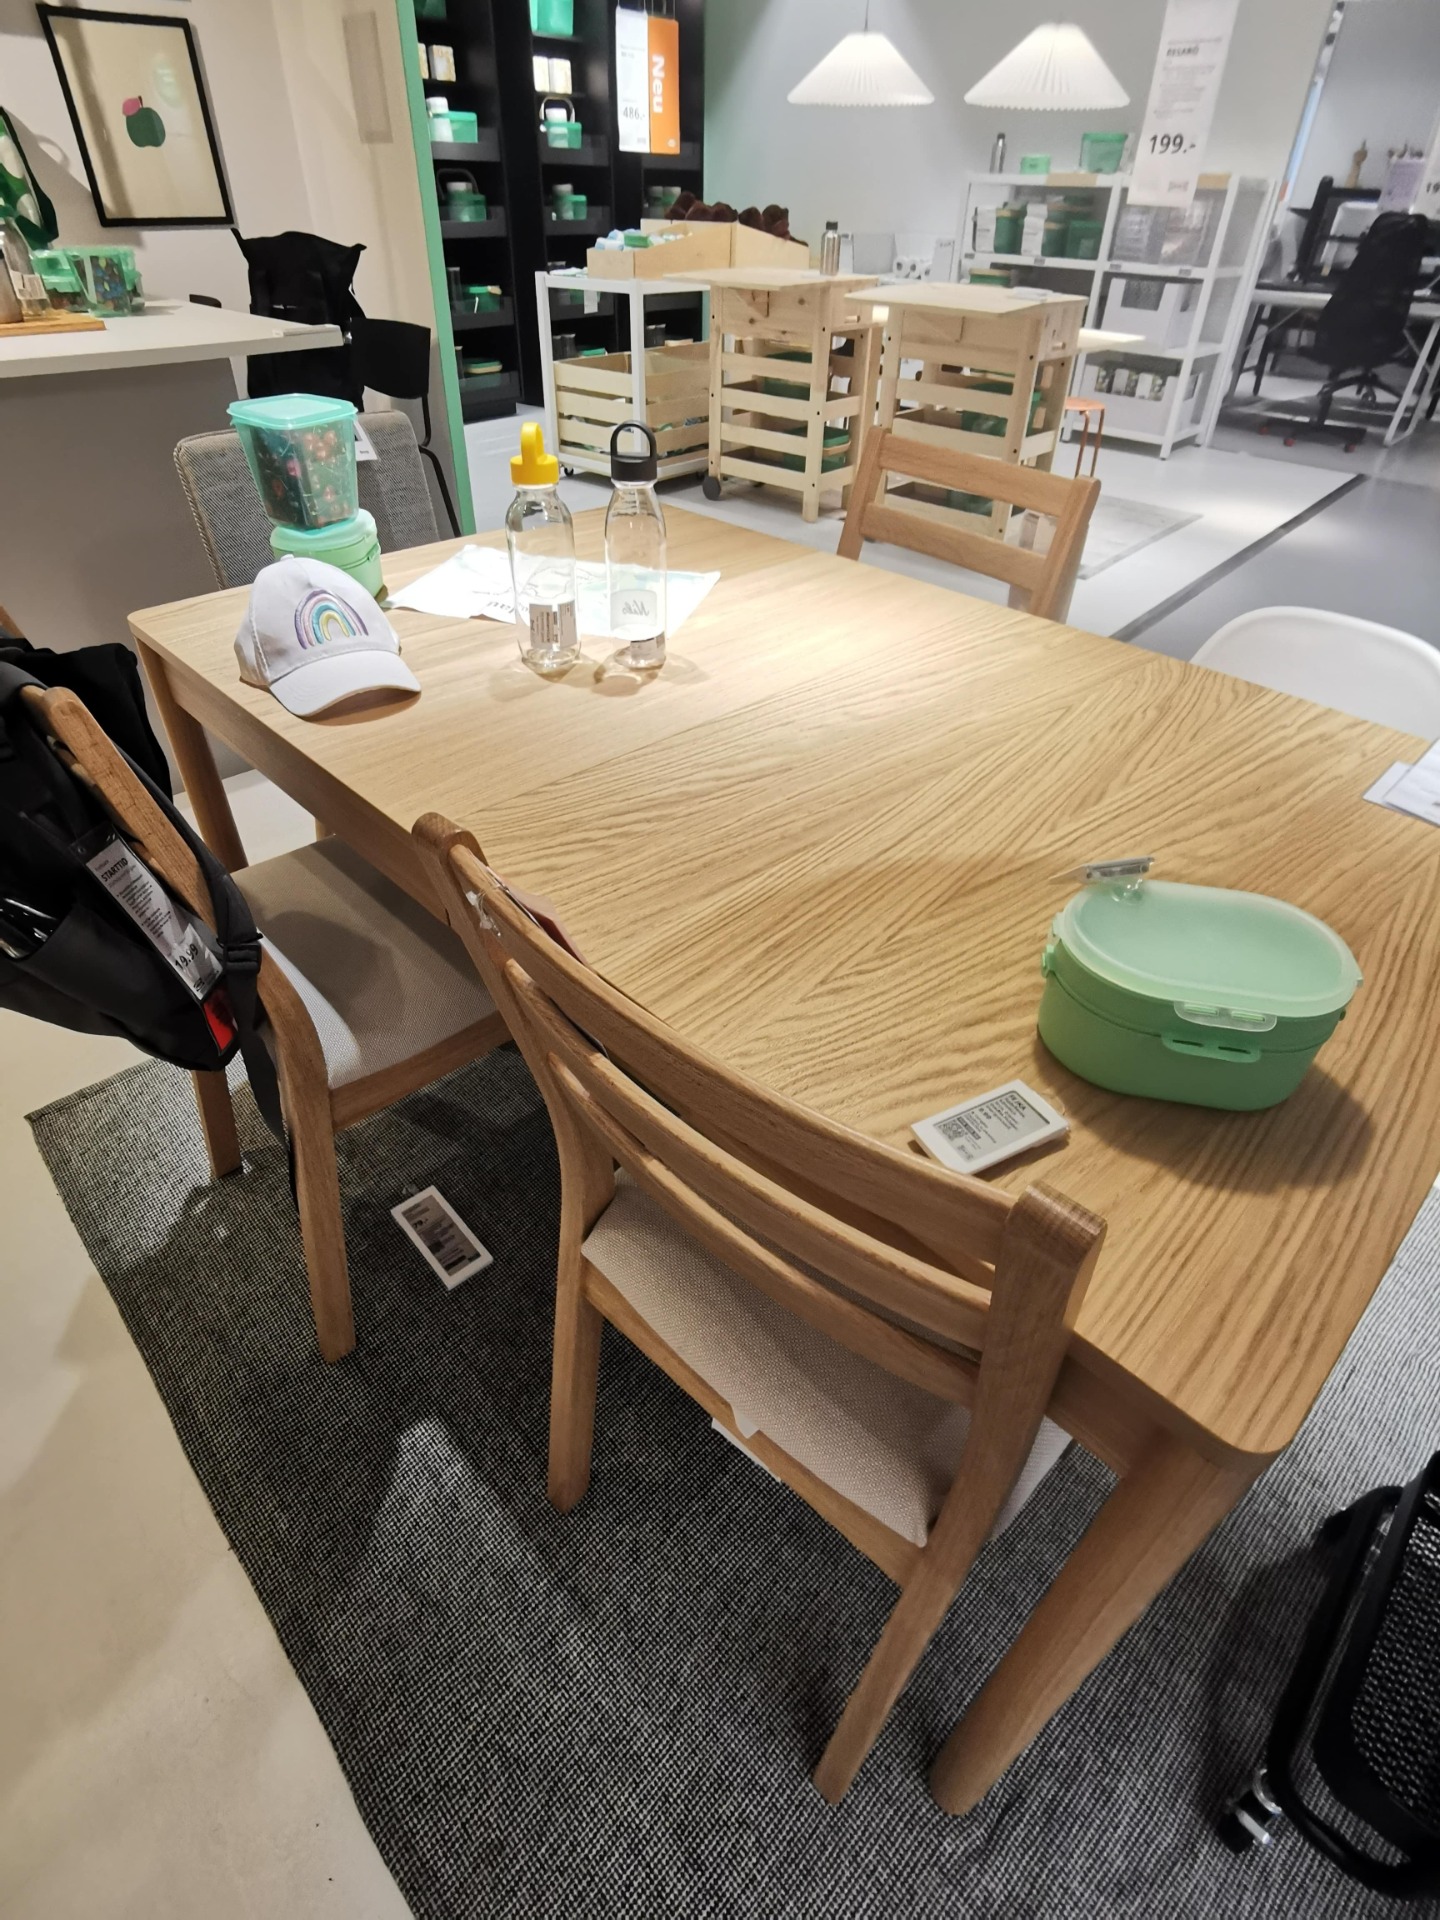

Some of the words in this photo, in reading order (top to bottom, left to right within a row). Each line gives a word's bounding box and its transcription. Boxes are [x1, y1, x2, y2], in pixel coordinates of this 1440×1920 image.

[652, 54, 665, 113] Neu
[1150, 133, 1196, 154] 199.-
[101, 857, 128, 882] STARTTID
[174, 943, 199, 971] 19.99
